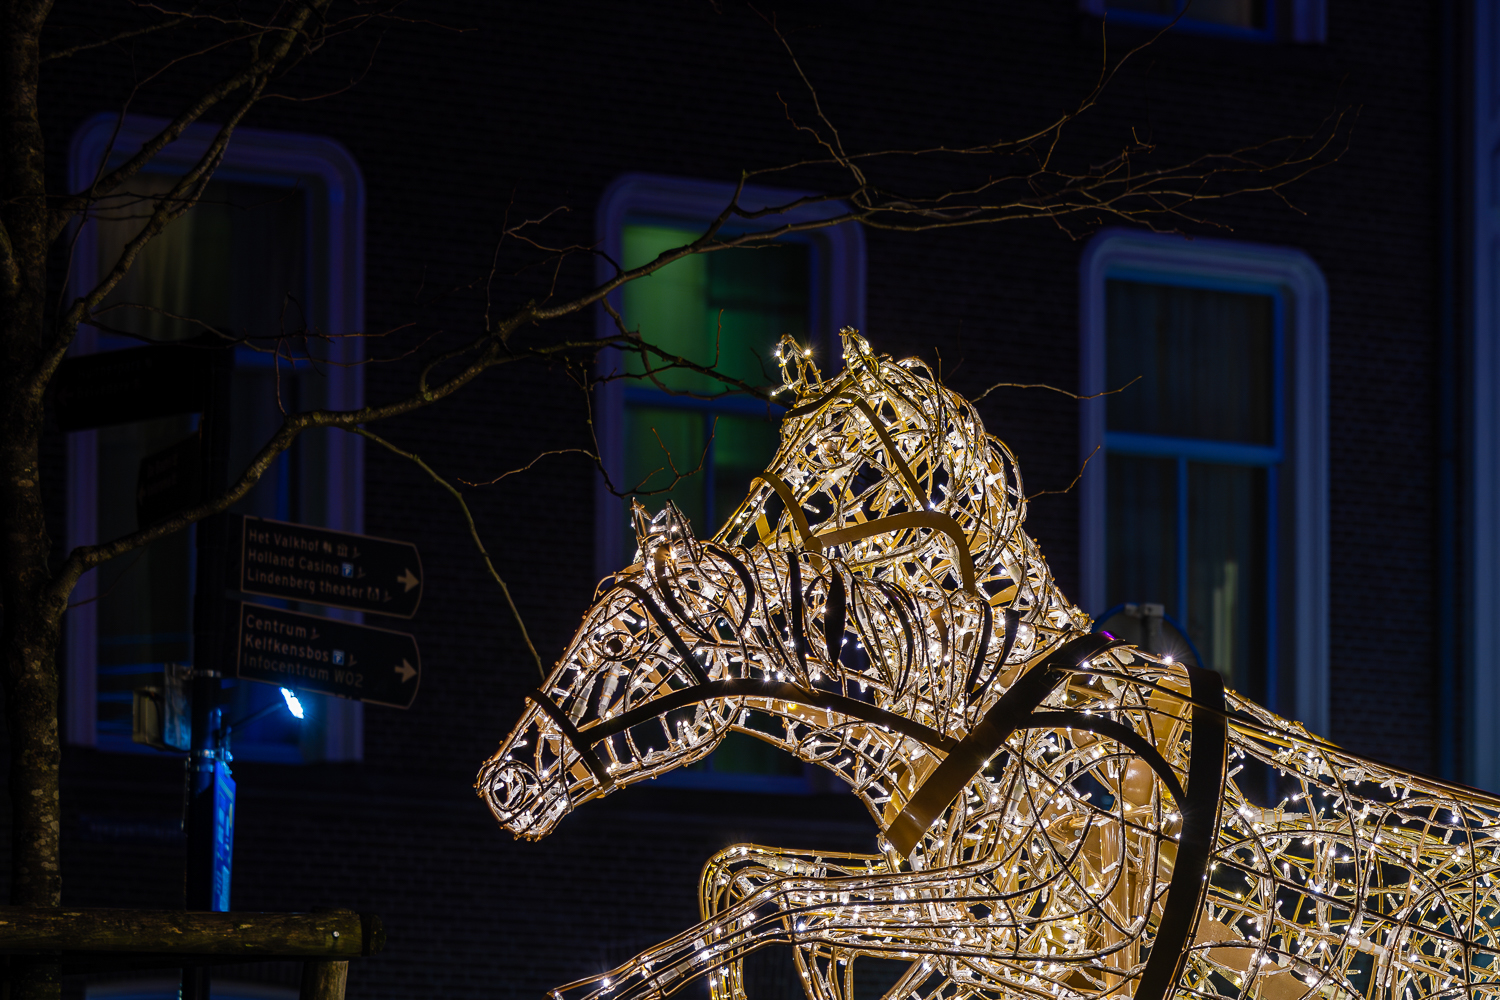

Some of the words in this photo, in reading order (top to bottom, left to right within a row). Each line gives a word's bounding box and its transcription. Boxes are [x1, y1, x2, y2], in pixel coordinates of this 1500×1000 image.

[249, 529, 270, 543] Het
[274, 533, 319, 552] Valkhof
[248, 548, 294, 568] Holland
[299, 557, 339, 575] Casino
[247, 567, 315, 595] Lindenberg
[320, 580, 364, 599] theater
[246, 614, 307, 639] Centrum
[245, 633, 329, 662] Kelfkensbos
[244, 653, 329, 681] Infocentrum
